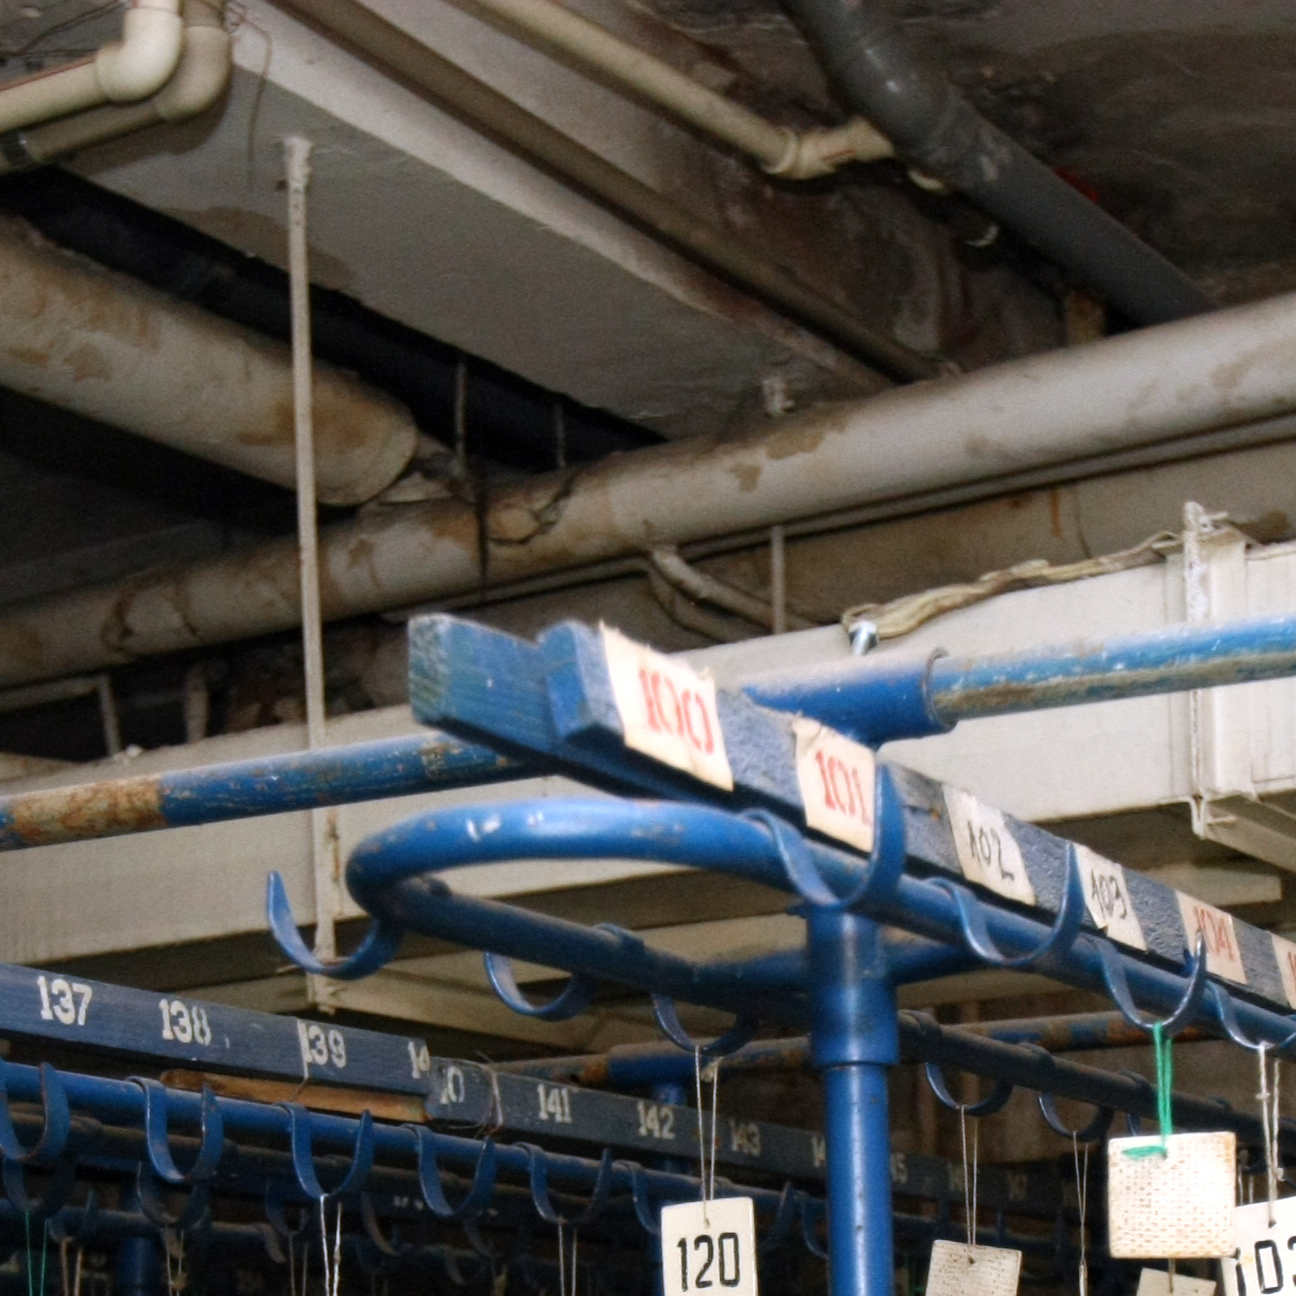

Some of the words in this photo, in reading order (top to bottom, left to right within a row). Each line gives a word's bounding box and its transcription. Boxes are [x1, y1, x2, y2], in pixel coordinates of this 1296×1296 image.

[638, 667, 715, 755] 100
[815, 750, 871, 827] 101
[966, 820, 1015, 882] 102
[1090, 870, 1129, 920] 103
[36, 974, 94, 1027] 137
[159, 998, 212, 1046] 138
[297, 1019, 346, 1068] 139
[536, 1083, 573, 1124] 141
[636, 1100, 677, 1141] 142
[677, 1231, 741, 1292] 120
